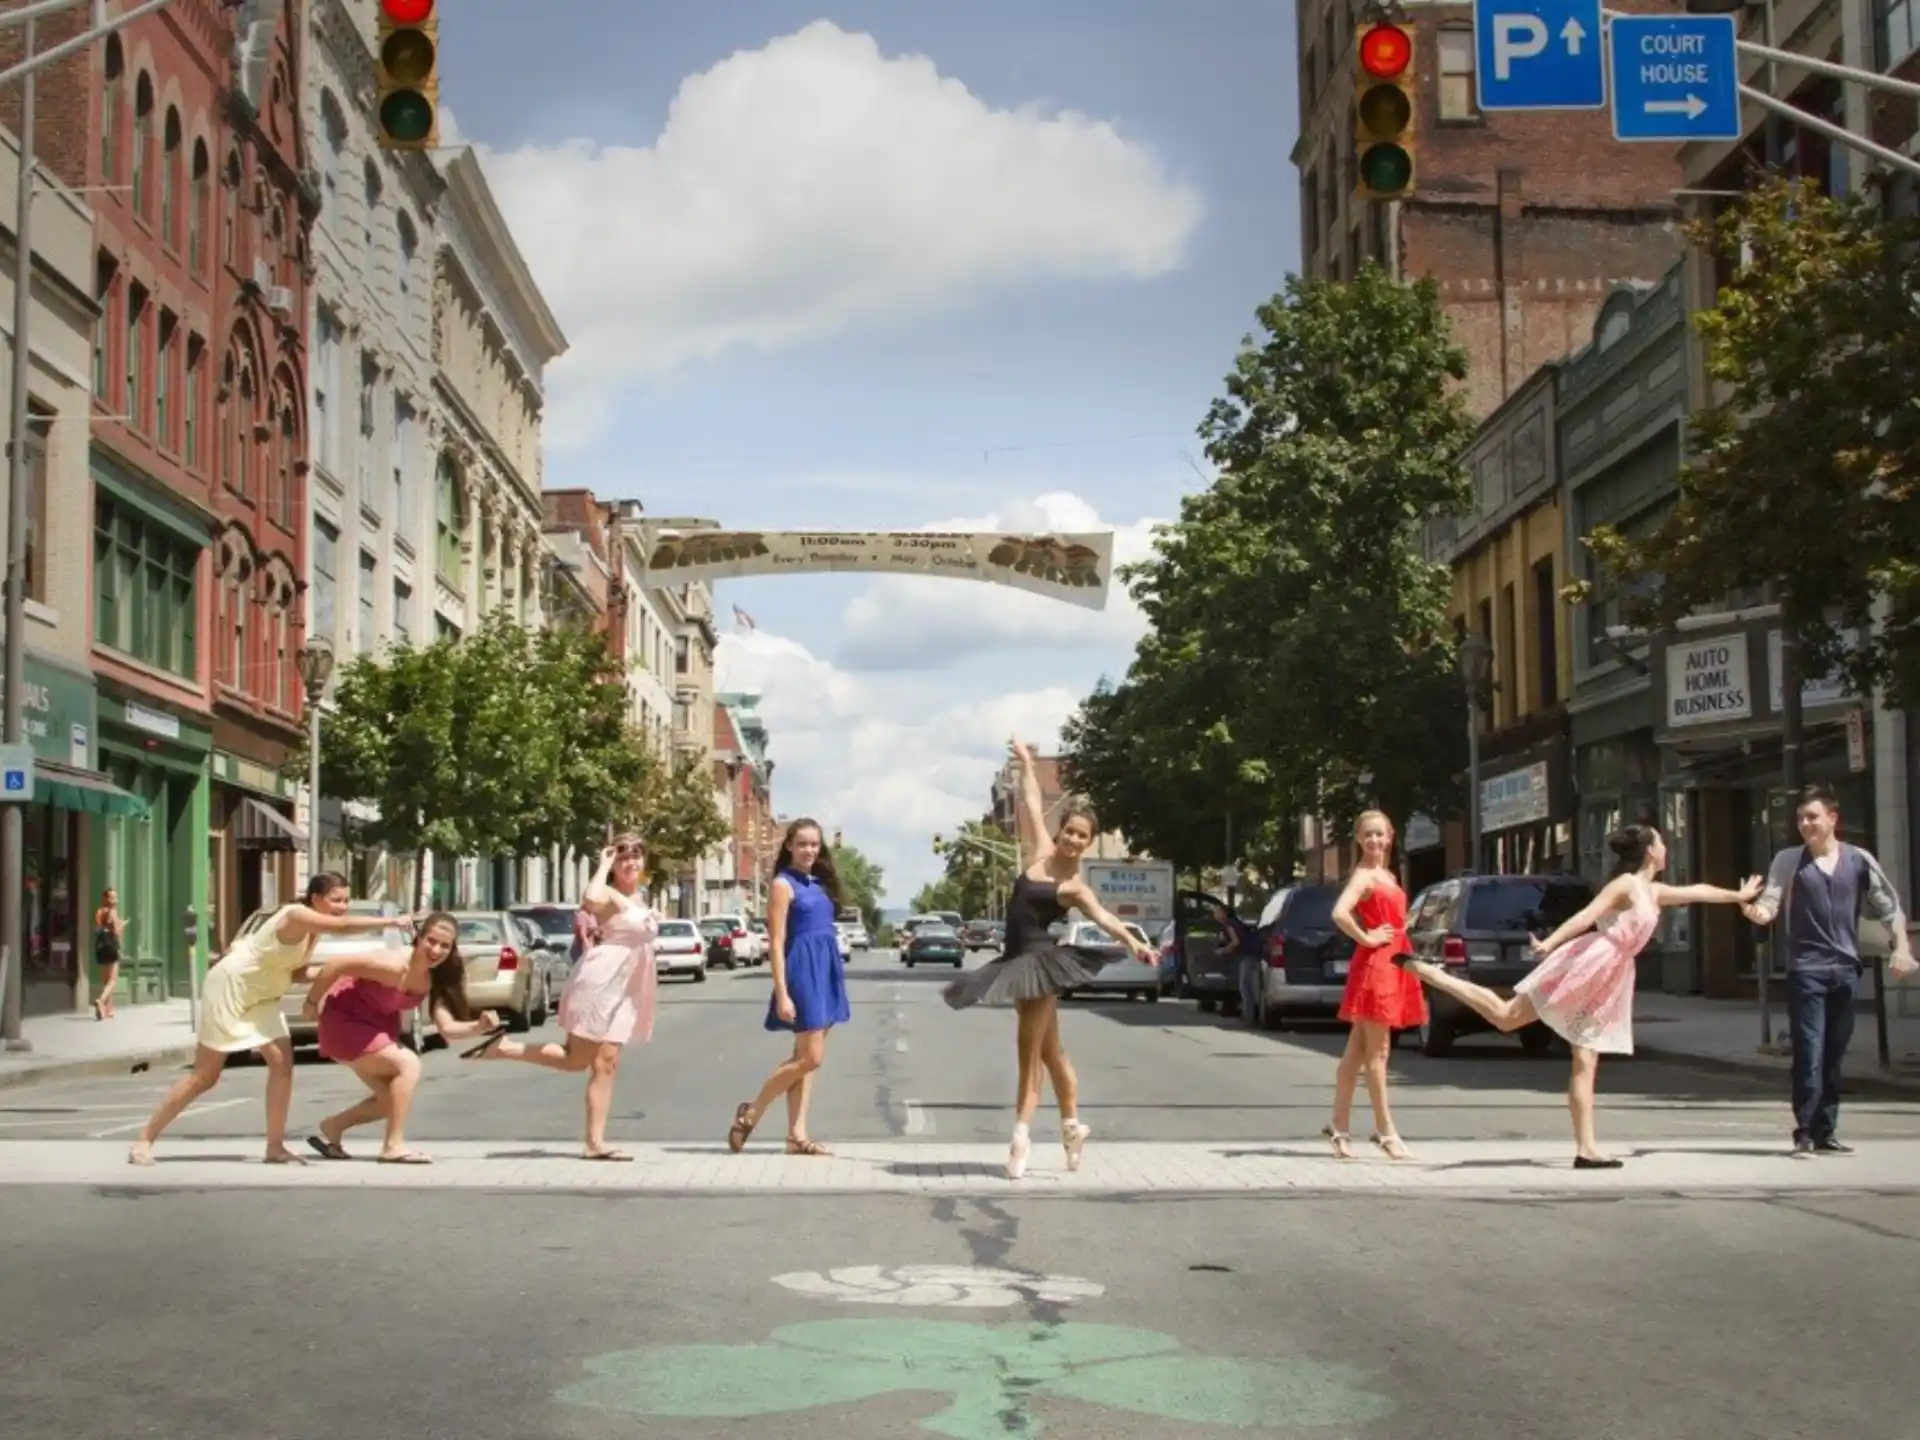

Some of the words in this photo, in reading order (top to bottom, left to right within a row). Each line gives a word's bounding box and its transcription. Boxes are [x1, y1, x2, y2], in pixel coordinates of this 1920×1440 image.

[1493, 14, 1549, 80] P
[1640, 35, 1706, 54] COURT
[1641, 64, 1709, 83] HOUSE
[1685, 647, 1730, 671] AUTO
[1685, 669, 1731, 693] HOME
[1674, 688, 1745, 716] BUSINESS
